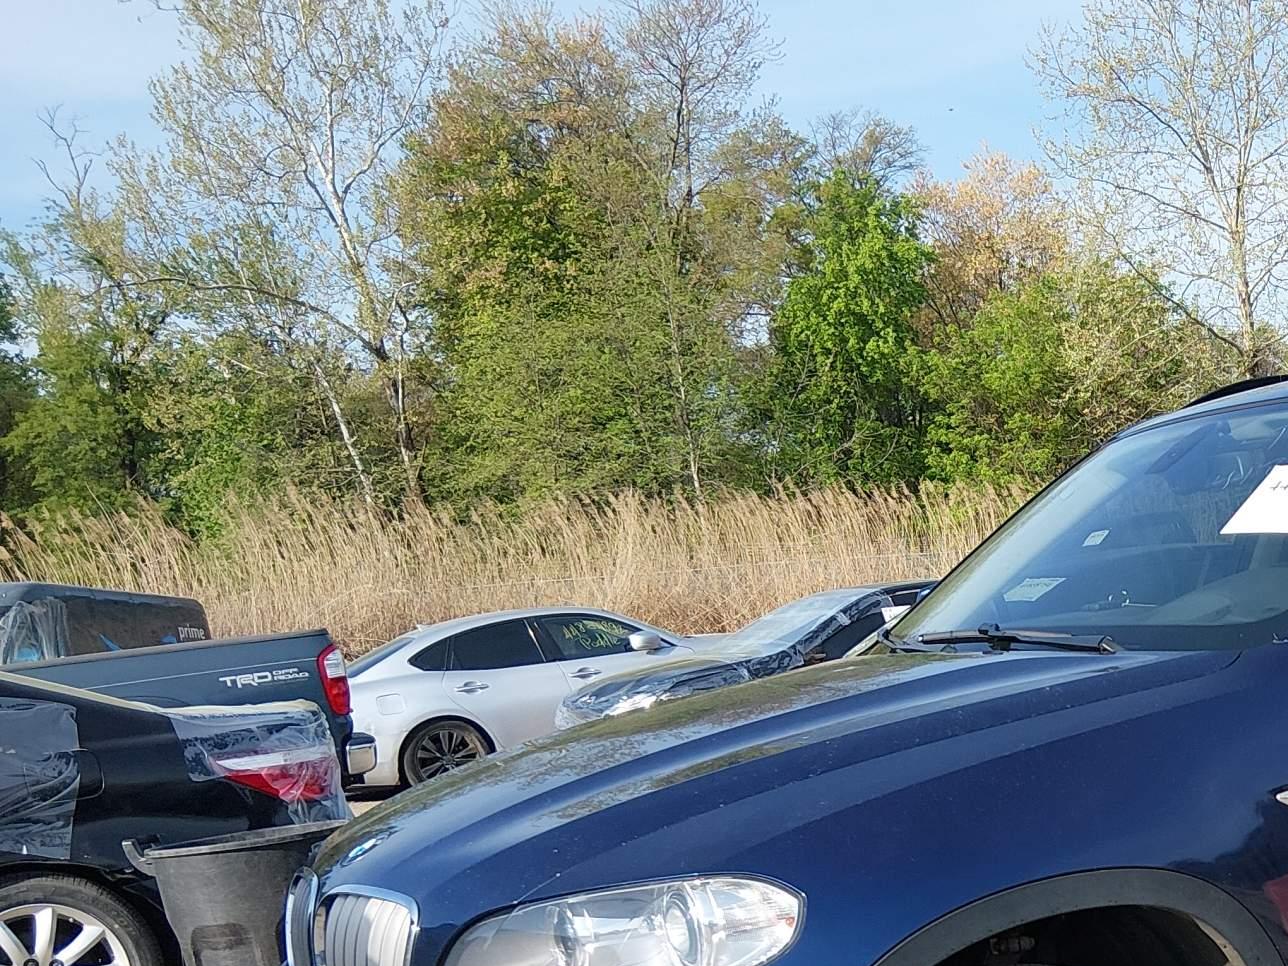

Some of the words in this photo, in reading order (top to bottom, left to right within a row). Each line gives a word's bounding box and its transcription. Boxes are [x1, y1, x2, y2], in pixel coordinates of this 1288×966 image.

[178, 624, 205, 641] prime
[272, 667, 299, 676] OFF
[273, 672, 309, 681] ROAD
[219, 672, 272, 689] TRD
